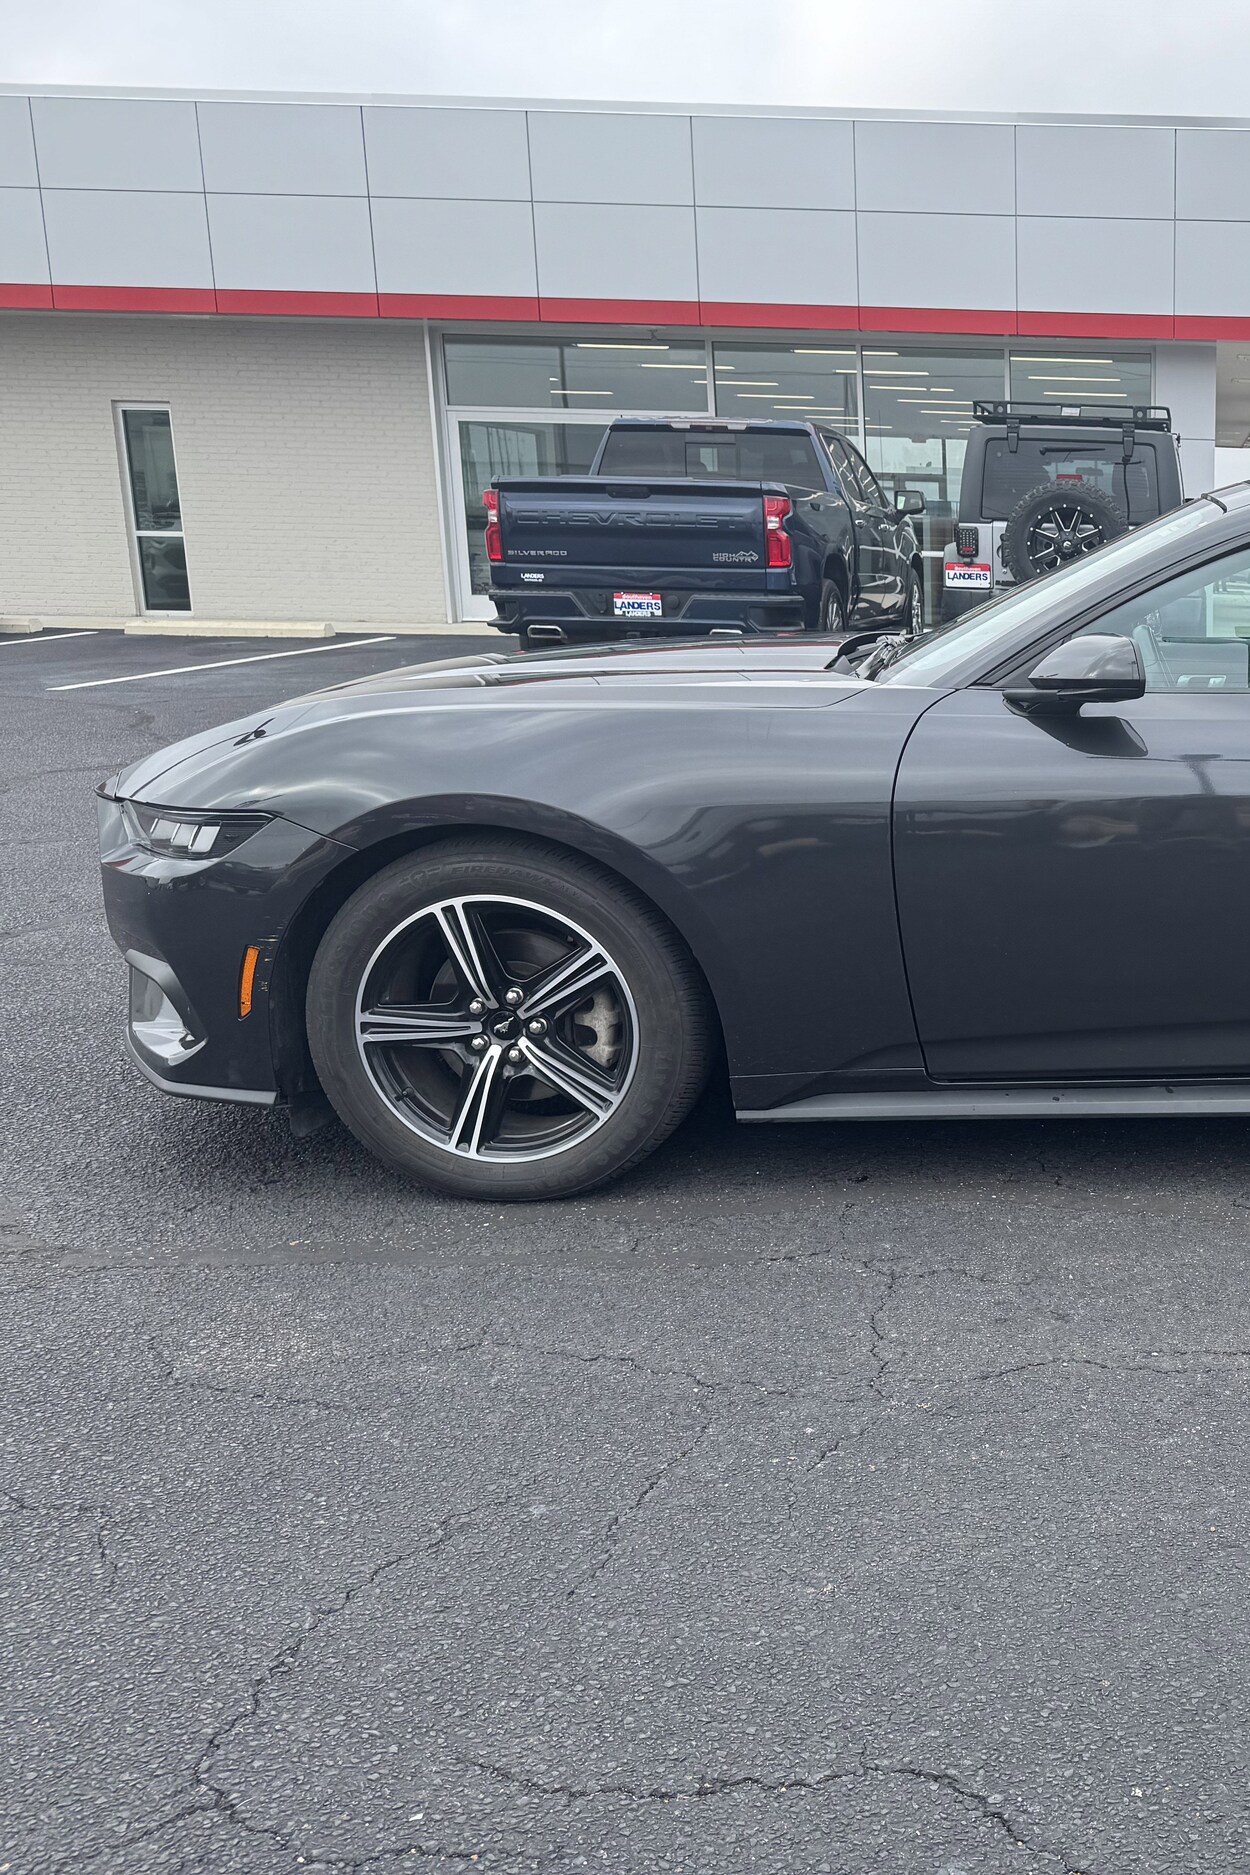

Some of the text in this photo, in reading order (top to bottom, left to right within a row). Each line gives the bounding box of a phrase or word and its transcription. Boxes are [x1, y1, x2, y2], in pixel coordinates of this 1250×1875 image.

[517, 510, 744, 529] CHEVROLET
[947, 572, 988, 581] LANDERS
[614, 601, 661, 611] LANDERS
[450, 864, 557, 890] FIREHAWK
